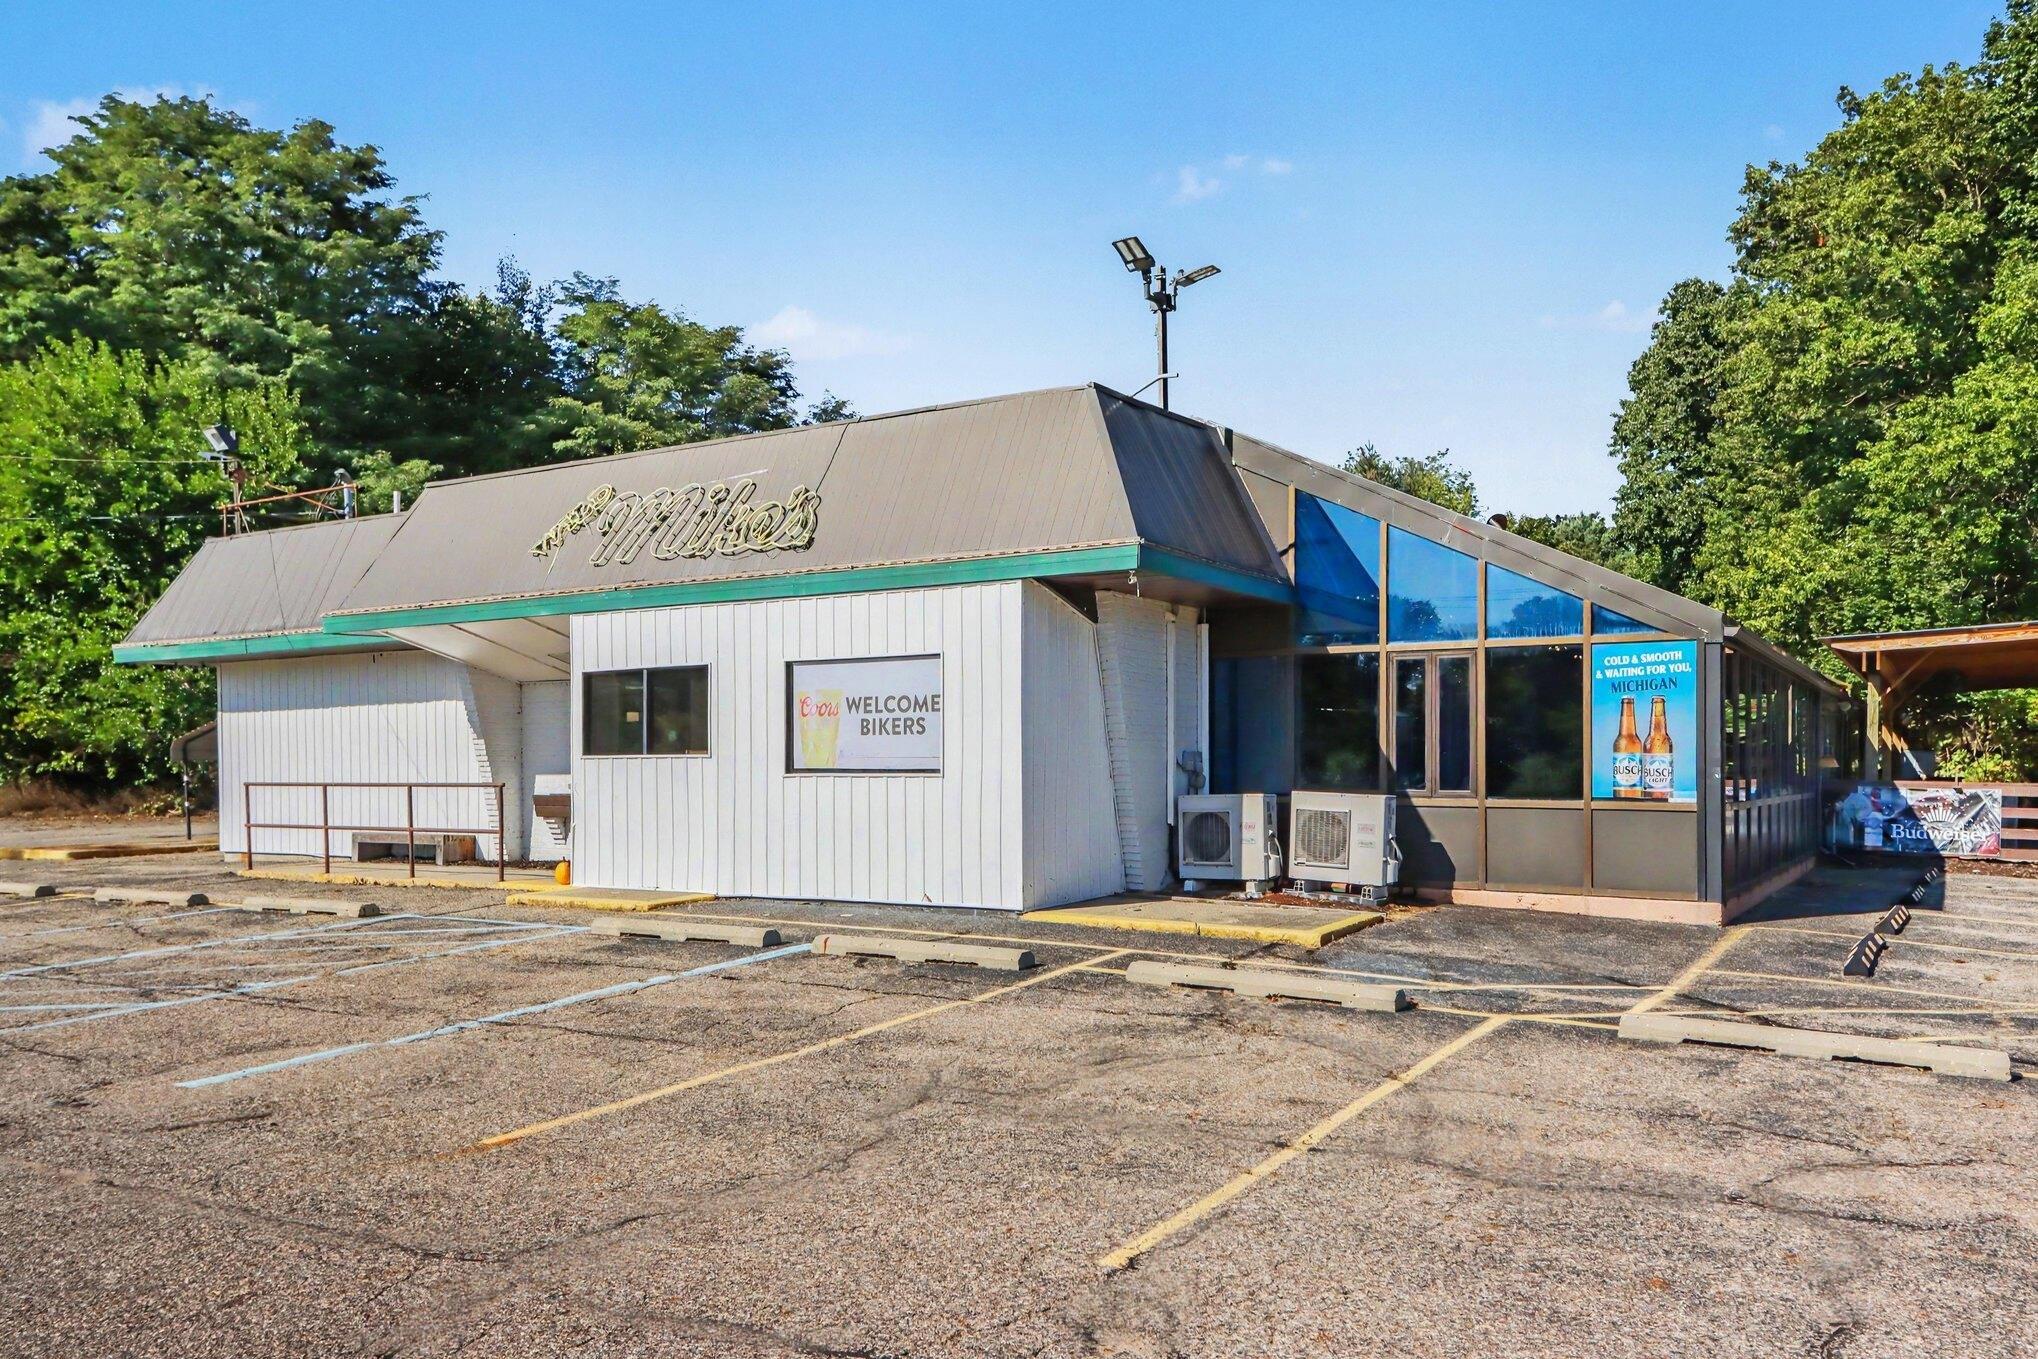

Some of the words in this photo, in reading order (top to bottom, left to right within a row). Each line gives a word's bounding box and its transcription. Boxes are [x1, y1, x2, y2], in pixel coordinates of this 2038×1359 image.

[589, 479, 820, 567] Mike's
[1604, 655, 1629, 666] COLD
[1631, 654, 1638, 664] &
[1640, 650, 1682, 663] SMOOTH
[1595, 670, 1603, 679] &
[1605, 667, 1644, 678] WAITING
[1646, 665, 1666, 675] FOR
[1611, 677, 1678, 693] MICHIGAN
[800, 696, 840, 718] Coors
[845, 694, 941, 715] WELCOME
[860, 717, 927, 736] BIKERS
[1613, 765, 1642, 775] BUSCH
[1644, 767, 1672, 778] BUSCH
[1890, 823, 1988, 842] Budweiser
